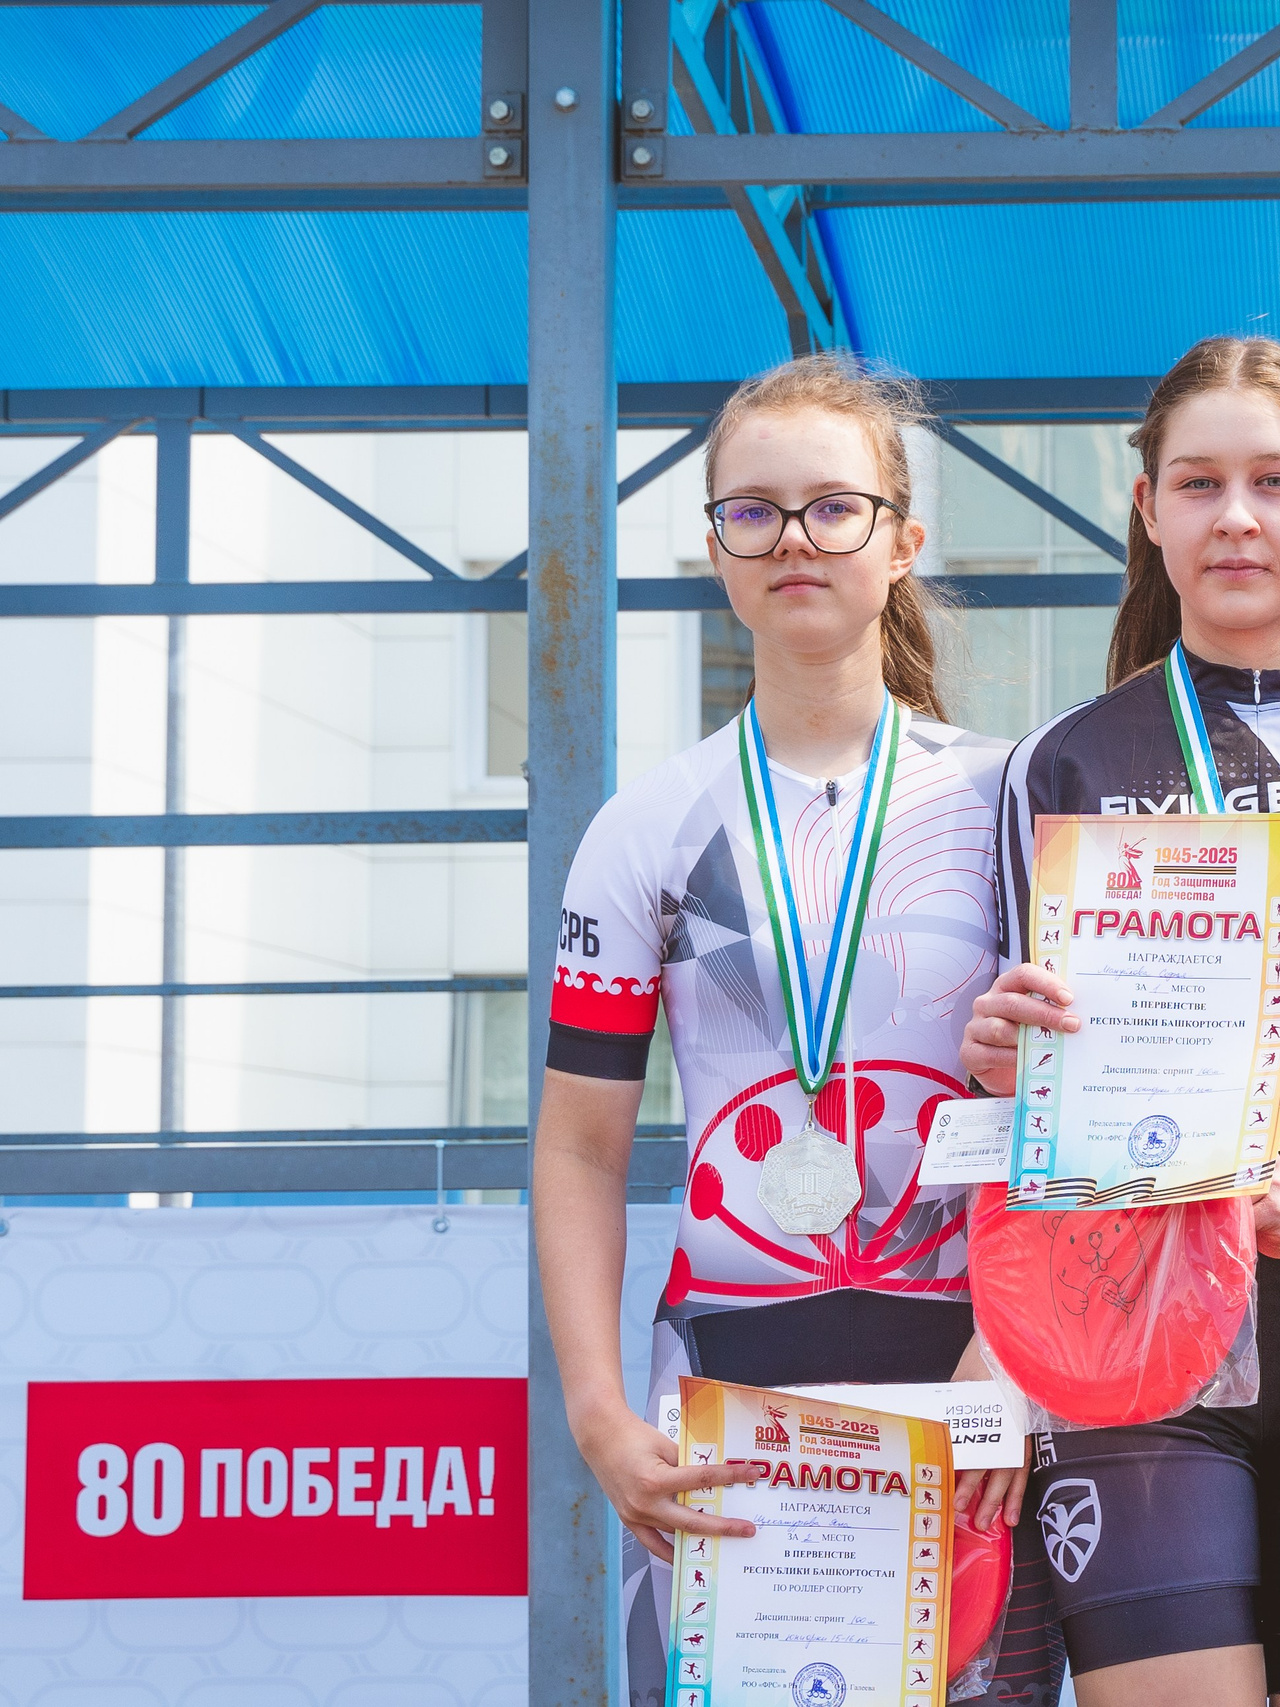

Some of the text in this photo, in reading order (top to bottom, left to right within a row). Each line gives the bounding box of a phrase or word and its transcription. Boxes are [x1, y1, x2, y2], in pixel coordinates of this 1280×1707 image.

[1155, 847, 1238, 864] 1945-2025
[1106, 872, 1126, 888] 80
[1152, 876, 1236, 888] Год Защитника
[1105, 891, 1142, 900] ПОБЕДА!
[1151, 890, 1215, 901] Отечества
[1072, 909, 1263, 941] ГРАМОТА
[559, 908, 600, 958] СРБ
[1128, 953, 1222, 964] НАГРАЖДАЕТСЯ
[1135, 983, 1147, 991] ЗА
[1172, 985, 1205, 993] МЕСТО
[1140, 1001, 1206, 1010] ПЕРВЕНСТВЕ
[1090, 1017, 1246, 1028] РЕСПУБЛИКИ БАШКОРТОСТАН
[1137, 1036, 1173, 1045] РОЛЛЕР
[1176, 1037, 1213, 1046] СПОРТУ
[1102, 1064, 1160, 1075] Дисциплина:
[1163, 1067, 1194, 1076] спринт
[1082, 1084, 1126, 1092] категория
[1089, 1120, 1132, 1128] Председатель
[946, 1404, 1003, 1415] ФРИСБИ
[798, 1413, 879, 1435] 1945-2025
[755, 1426, 773, 1441] 80
[755, 1442, 790, 1452] ПОБЕДА!
[800, 1434, 880, 1452] Год Защитника
[800, 1445, 860, 1460] Отечества
[77, 1441, 496, 1538] 80 ПОБЕДА!
[780, 1501, 871, 1515] НАГРАЖДАЕТСЯ
[803, 1533, 812, 1542] 2
[822, 1534, 854, 1542] МЕСТО
[784, 1550, 856, 1559] В ПЕРВЕНСТВЕ
[743, 1566, 895, 1578] РЕСПУБЛИКИ БАШКОРТОСТАН
[773, 1584, 863, 1594] ПО РОЛЛЕР СПОРТУ
[754, 1612, 812, 1622] Дисциплина:
[814, 1615, 845, 1624] спринт
[735, 1632, 779, 1641] категория
[742, 1666, 786, 1674] Председатель
